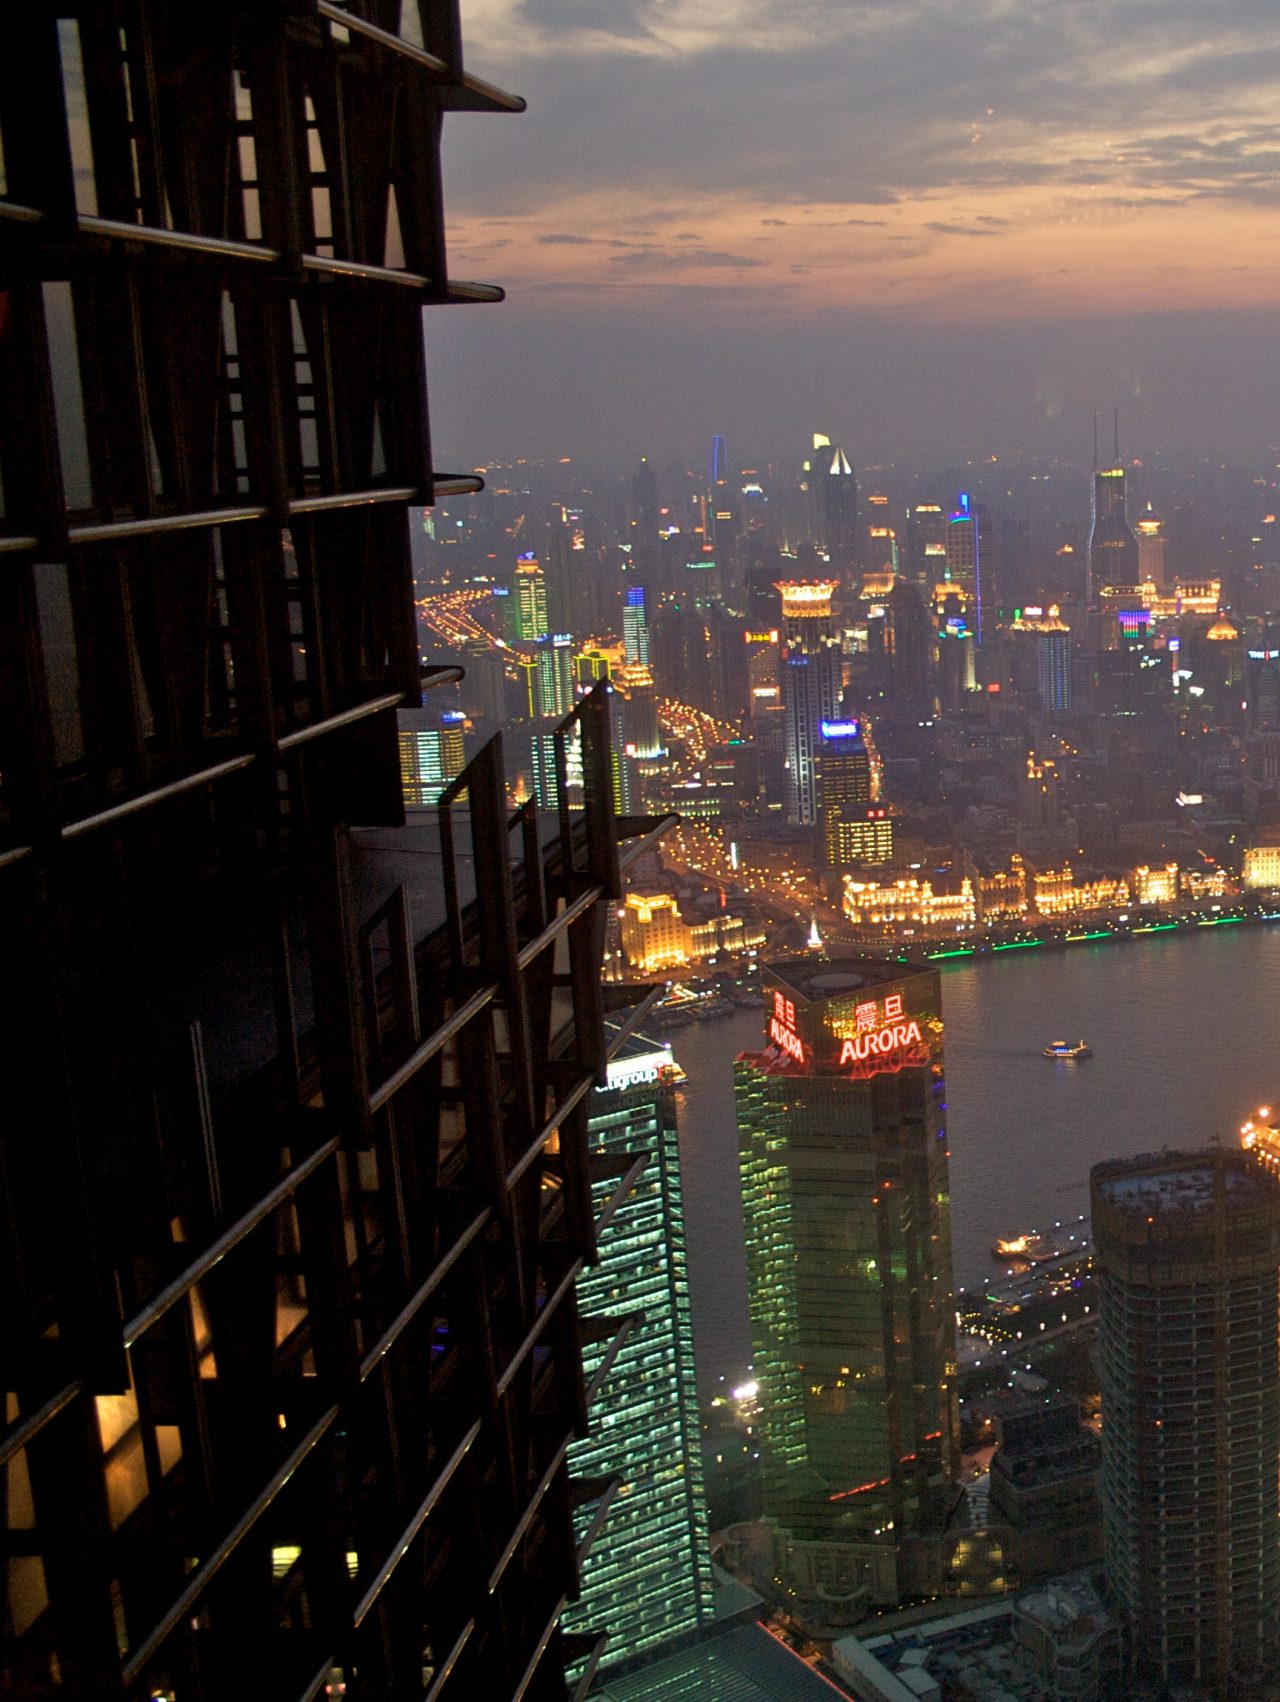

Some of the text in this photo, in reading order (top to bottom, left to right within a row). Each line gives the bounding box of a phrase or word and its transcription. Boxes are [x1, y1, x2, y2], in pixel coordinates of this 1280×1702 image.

[856, 994, 905, 1032] 震旦
[771, 1018, 804, 1063] AURORA
[840, 1022, 921, 1065] AURORA
